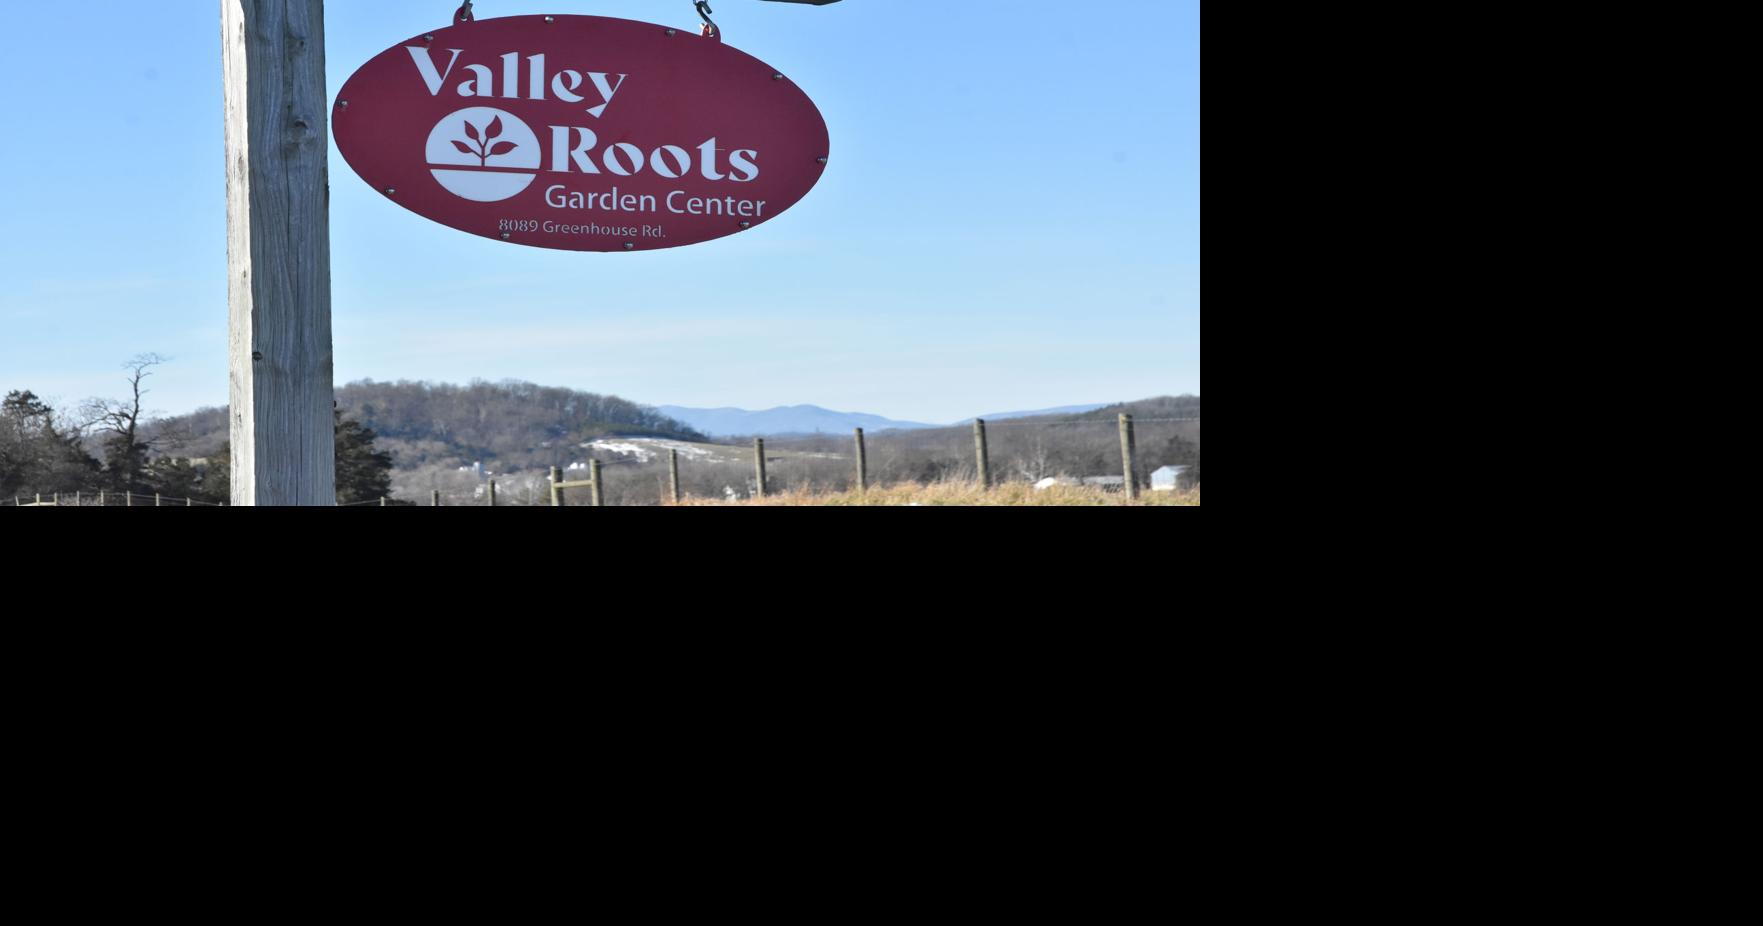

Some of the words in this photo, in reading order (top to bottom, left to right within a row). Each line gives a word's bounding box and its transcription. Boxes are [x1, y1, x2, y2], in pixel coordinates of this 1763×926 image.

[404, 46, 628, 118] Valley
[548, 125, 760, 182] Roots
[545, 185, 657, 212] Garden
[666, 190, 766, 217] Center
[499, 219, 538, 232] 8089
[543, 220, 637, 237] Greenhouse
[642, 225, 666, 238] Rd.
